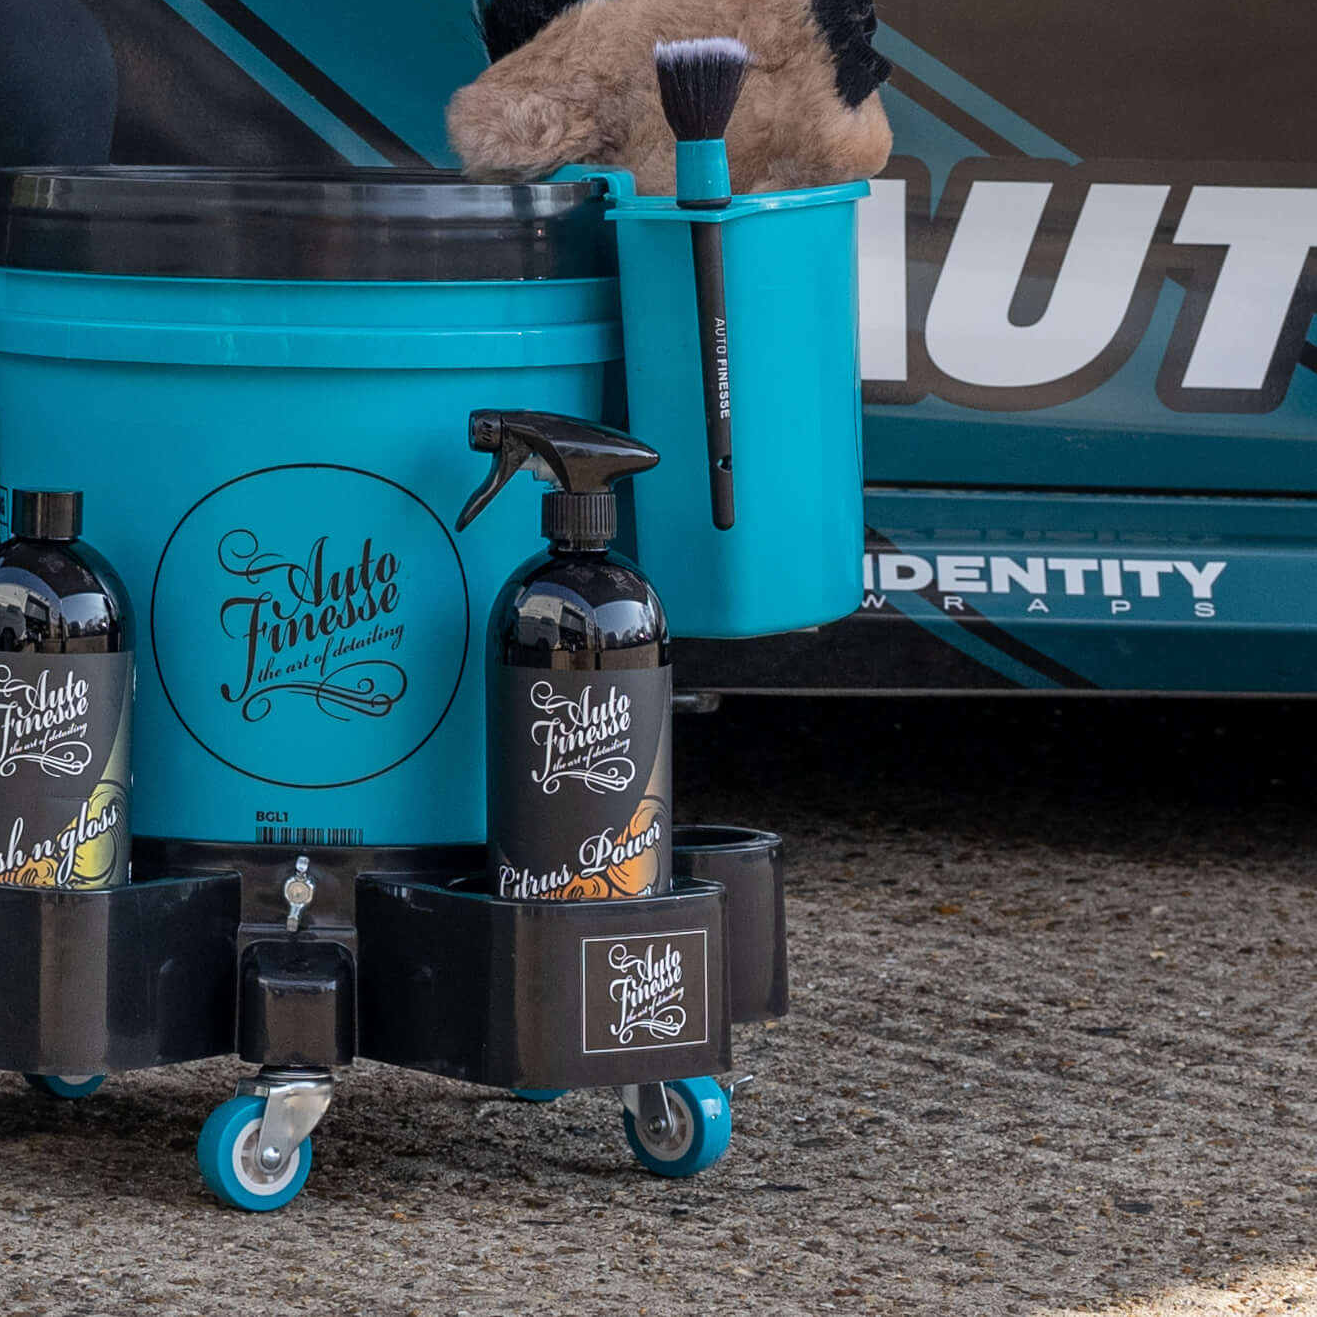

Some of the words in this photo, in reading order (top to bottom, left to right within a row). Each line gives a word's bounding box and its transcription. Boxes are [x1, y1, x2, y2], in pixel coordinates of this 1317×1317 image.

[859, 179, 1317, 390] UT
[714, 316, 727, 354] AUTO
[717, 358, 731, 419] FINESSE
[218, 528, 401, 620] Auto
[862, 554, 1228, 599] IDENTITY
[861, 594, 1216, 618] WRAPS
[220, 582, 401, 703] Finesse
[258, 656, 282, 683] the
[285, 653, 309, 674] art
[314, 635, 334, 677] of
[332, 623, 405, 658] detailing
[530, 681, 631, 735] Auto
[531, 710, 631, 783] Finesse
[32, 838, 56, 860] n
[55, 801, 118, 884] gloss
[255, 811, 288, 822] BGL1
[499, 864, 572, 898] Citrus
[579, 820, 661, 878] Power
[608, 944, 682, 990] Auto
[609, 964, 682, 1035] Finesse
